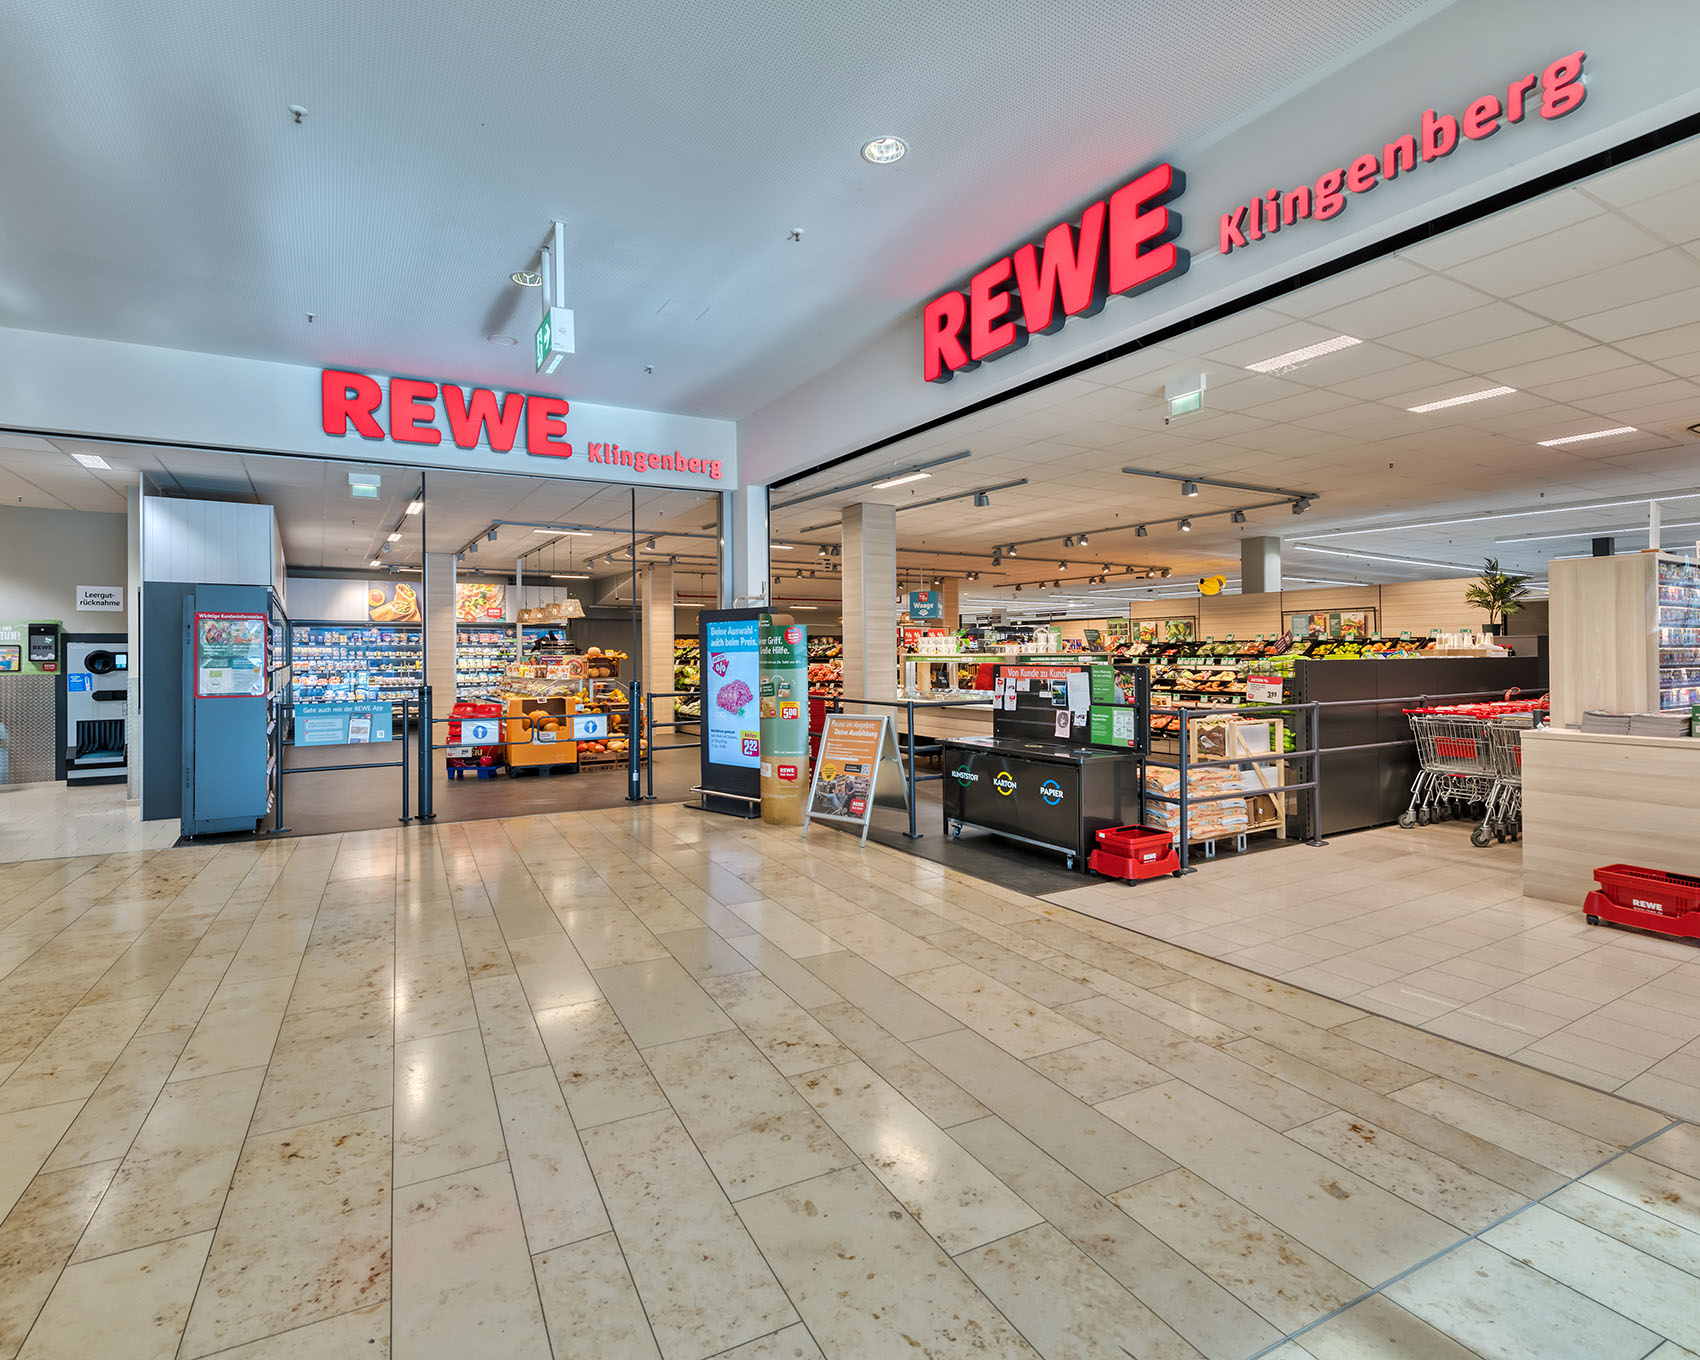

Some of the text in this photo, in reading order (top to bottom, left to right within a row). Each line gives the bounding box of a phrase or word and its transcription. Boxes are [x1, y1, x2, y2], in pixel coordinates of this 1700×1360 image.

[923, 49, 1587, 383] REWE Klingenberg
[321, 369, 723, 481] REWE Klingenberg
[84, 591, 116, 600] Leergut-
[79, 599, 121, 607] rücknahme
[913, 602, 934, 611] Waage
[710, 627, 728, 636] Deine
[728, 625, 754, 636] Auswahl
[710, 638, 725, 647] auch
[725, 637, 740, 647] beim
[740, 636, 758, 647] Preis.
[772, 645, 790, 655] Hilfe.
[1007, 668, 1020, 677] Von
[1020, 668, 1040, 678] Kunde
[1040, 671, 1049, 679] zu
[302, 706, 317, 714] Geht
[343, 705, 353, 713] der
[371, 704, 384, 713] App
[849, 728, 878, 739] Ausbildung
[951, 770, 980, 782] KUNSTSTOFF
[993, 777, 1017, 790] KARTON
[1040, 786, 1064, 799] PAPIER
[1632, 899, 1663, 911] REWE
